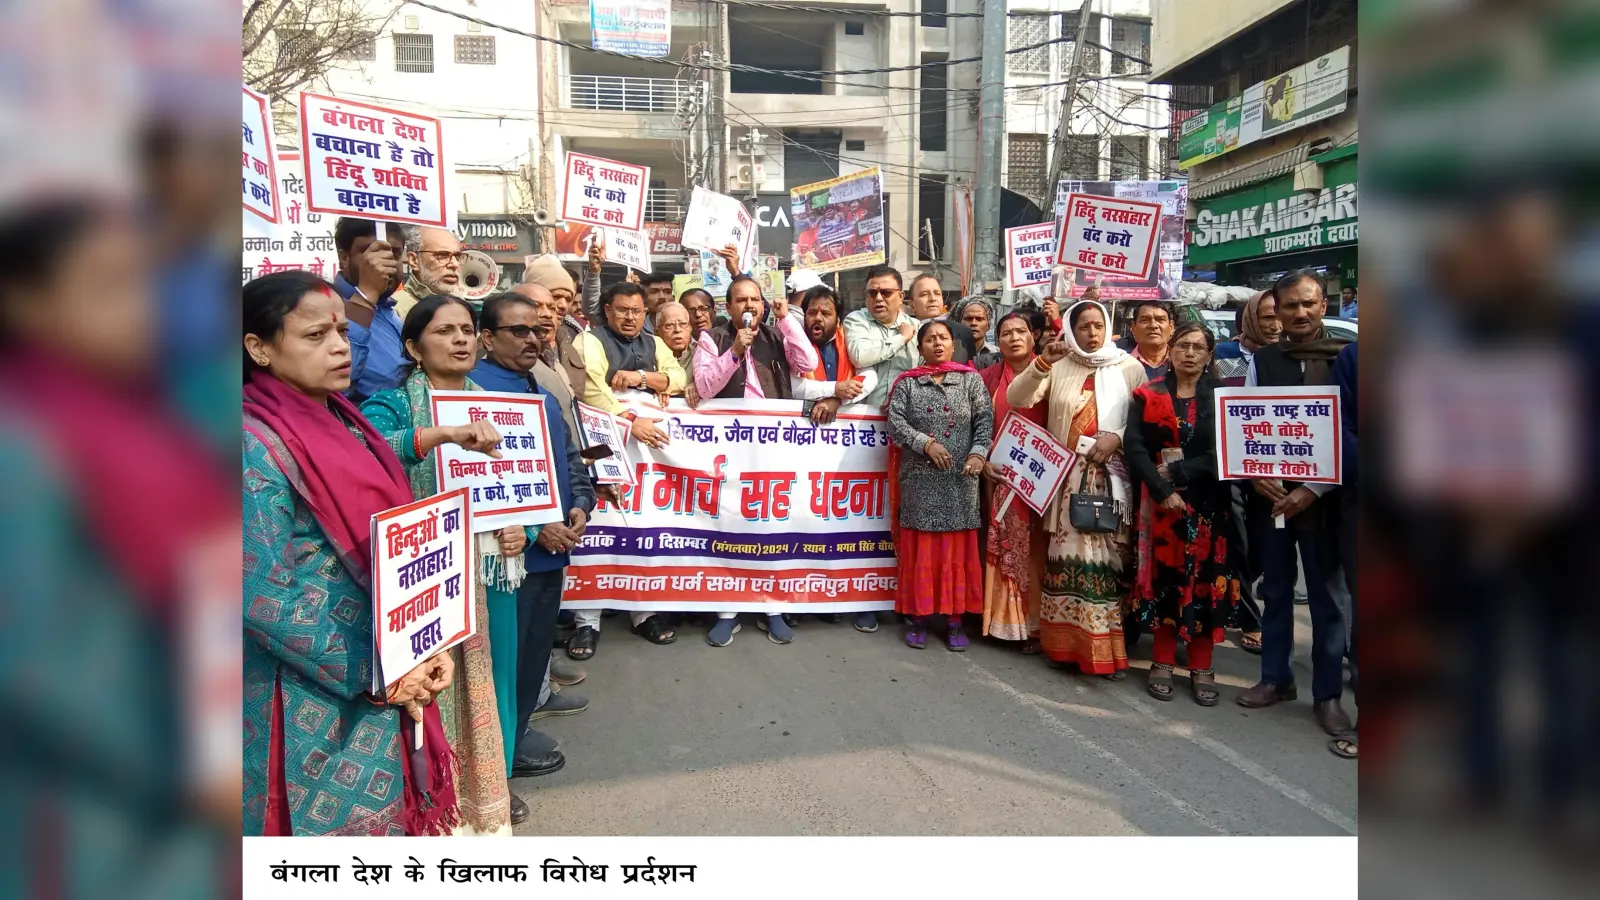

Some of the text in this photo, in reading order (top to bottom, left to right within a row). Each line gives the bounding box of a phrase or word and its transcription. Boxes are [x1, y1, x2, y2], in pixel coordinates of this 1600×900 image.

[320, 106, 426, 142] बंगला देश
[312, 133, 434, 168] बचाना है तो
[254, 157, 268, 179] का
[324, 156, 368, 188] हिंदू
[372, 167, 428, 191] शक्ति
[574, 160, 639, 186] हिंदू नरसंहार
[250, 181, 271, 206] करो
[335, 188, 421, 214] बढ़ाना है
[584, 183, 626, 204] बंद करो
[582, 204, 624, 224] बंद करो
[1075, 201, 1152, 226] हिंदू नरसंहार
[289, 230, 302, 252] में
[1083, 226, 1132, 247] बंद करो
[1014, 242, 1051, 256] बचाना
[1078, 248, 1128, 269] बंद करो
[1020, 255, 1042, 269] हिंदू
[492, 408, 524, 426] नरसंहार
[1228, 401, 1330, 420] सयुक्त राष्ट्र संघ
[504, 432, 518, 450] बंद
[520, 432, 536, 450] करो
[724, 418, 754, 444] जैन
[758, 421, 781, 444] एवं
[783, 420, 819, 446] बौद्धों
[821, 428, 839, 444] पर
[841, 423, 856, 446] हो
[859, 424, 876, 447] रहे
[1242, 421, 1314, 440] चुप्पी तोड़ो,
[1008, 420, 1066, 468] हिंदू नरसंहार
[1244, 440, 1314, 456] हिंसा रोको
[449, 459, 546, 480] चिन्मय कृष्ण दास का
[1010, 446, 1046, 480] बंद करो
[1242, 459, 1318, 476] हिंसा रोको!
[484, 482, 510, 502] करो,
[512, 483, 532, 504] मुक्त
[534, 479, 549, 496] करो
[652, 454, 728, 520] मार्च
[740, 471, 798, 522] सह
[808, 471, 890, 520] धरना
[1020, 476, 1036, 498] करो
[386, 507, 460, 560] हिन्दुओं का
[636, 536, 654, 550] 10
[659, 532, 708, 550] दिसम्बर
[803, 543, 826, 554] स्थान
[859, 540, 875, 552] सिंह
[398, 541, 453, 590] नरसंहार!
[596, 574, 668, 592] सनातन
[670, 572, 704, 592] धर्म
[706, 576, 748, 592] सभा
[750, 576, 776, 592] एवं
[778, 574, 850, 597] पाटलिपुत्र
[388, 572, 461, 634] मानवता पर
[410, 617, 443, 660] प्रहार
